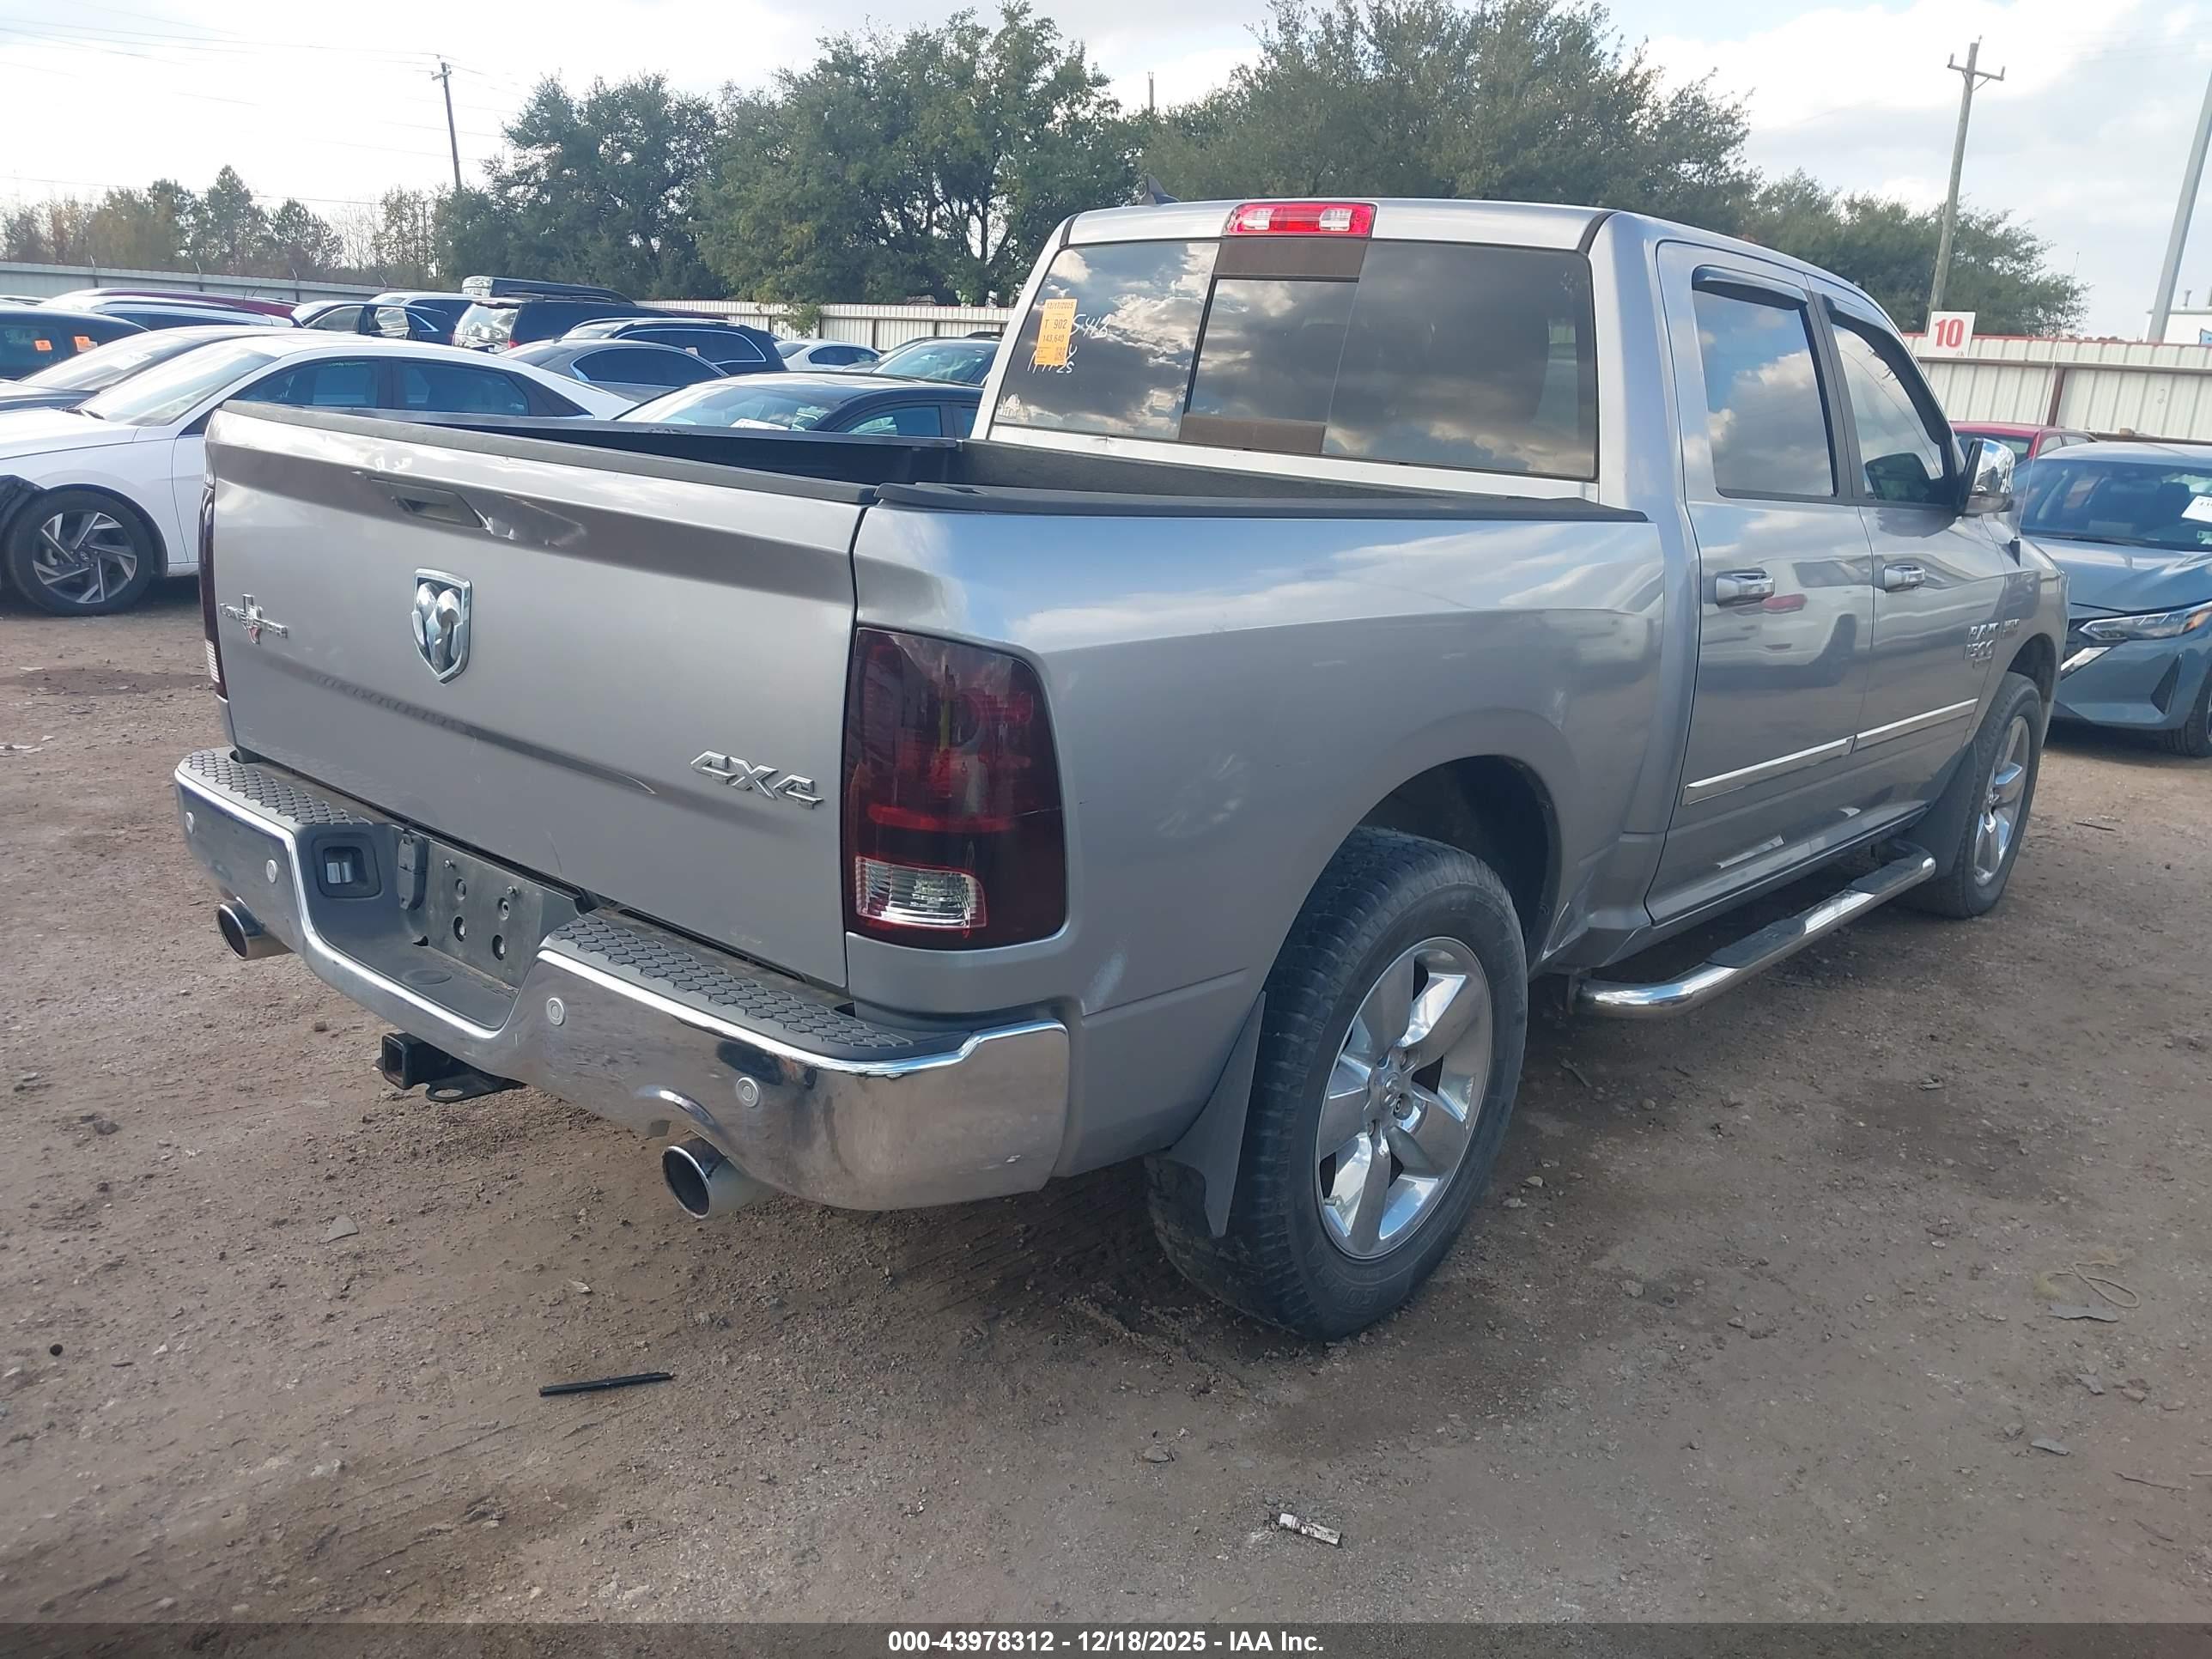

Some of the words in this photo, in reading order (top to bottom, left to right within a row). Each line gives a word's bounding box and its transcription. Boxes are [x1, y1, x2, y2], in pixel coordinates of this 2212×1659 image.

[1044, 319, 1049, 329] T
[1054, 319, 1067, 330] 902
[1935, 319, 1964, 347] 10
